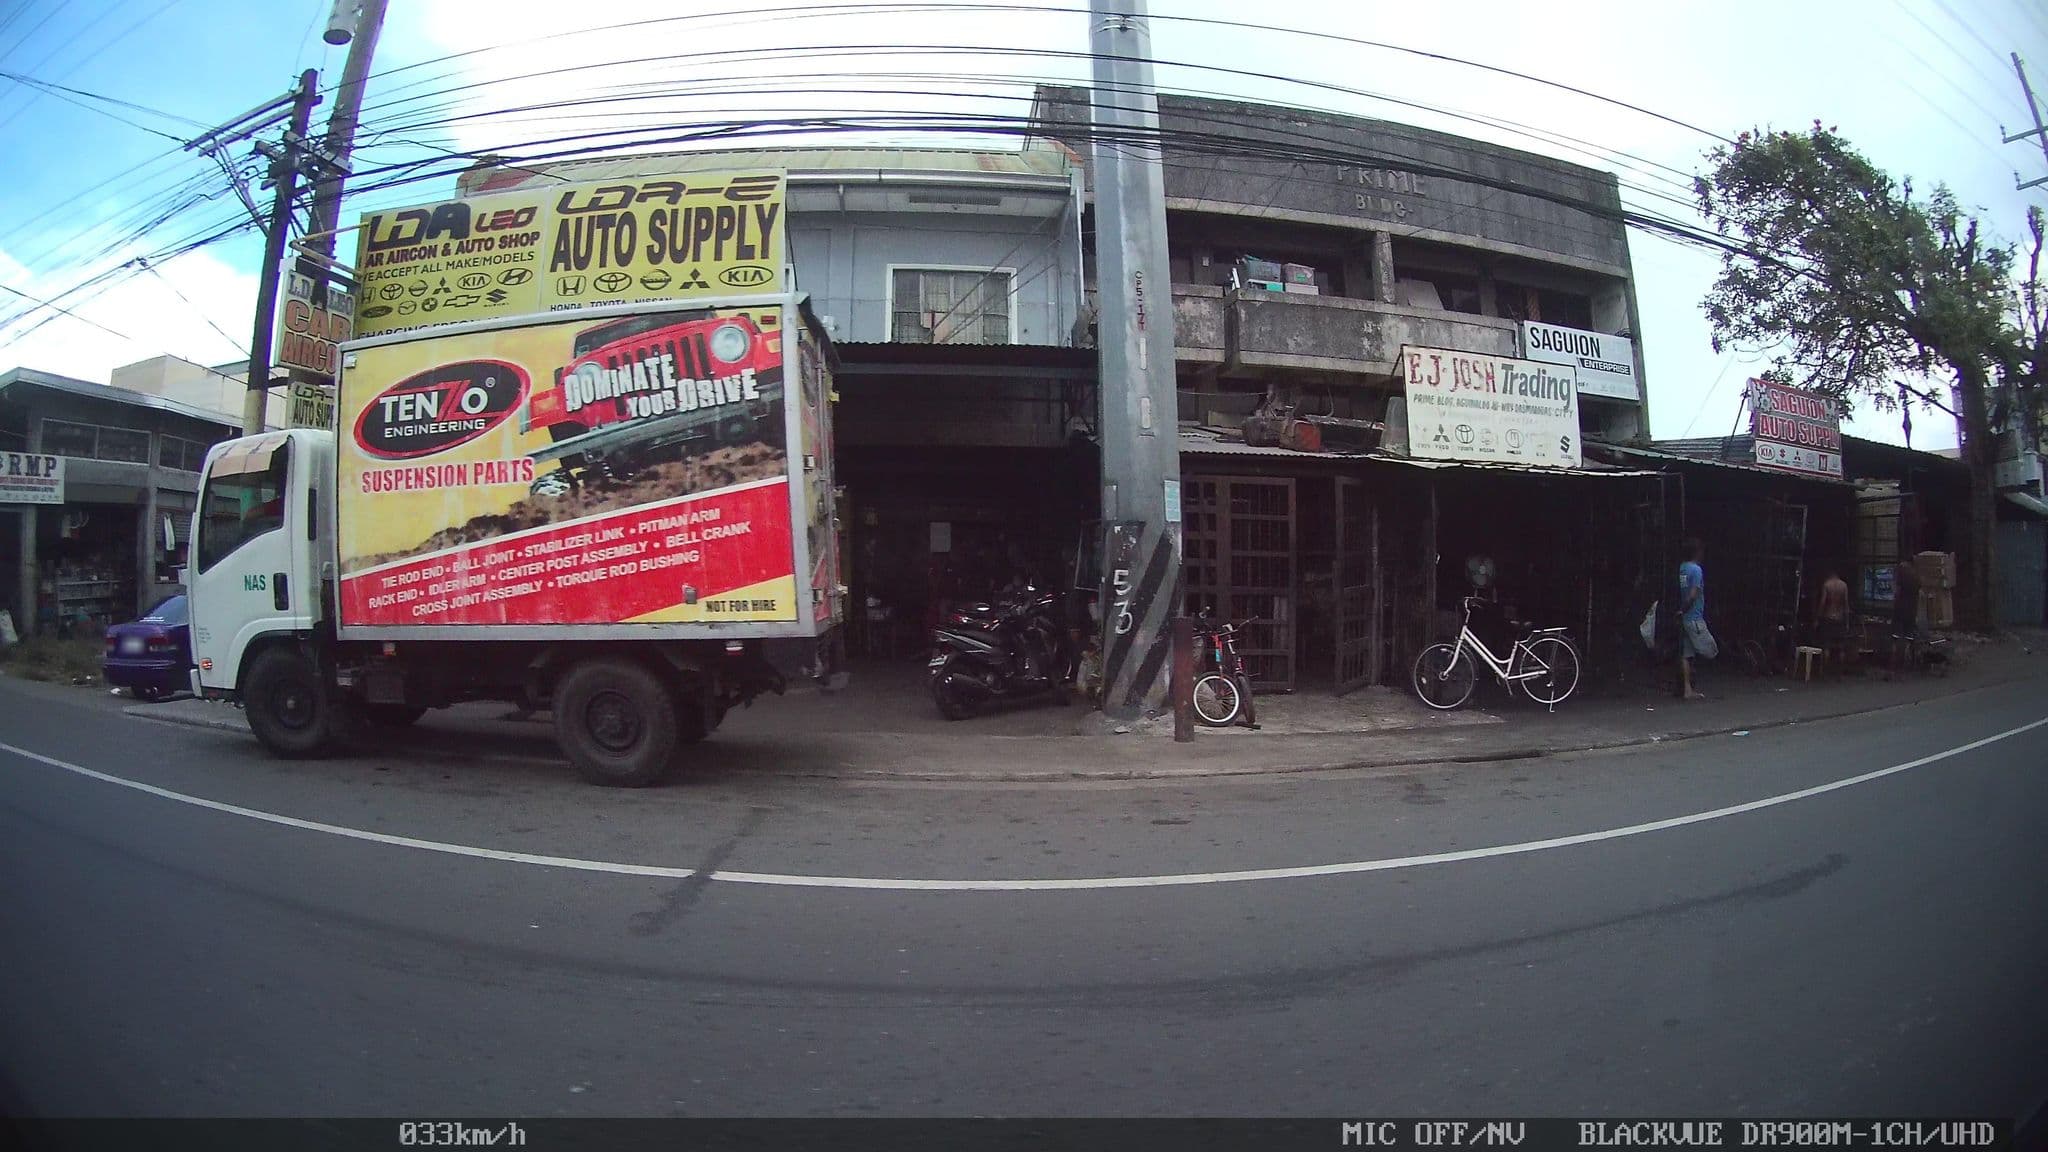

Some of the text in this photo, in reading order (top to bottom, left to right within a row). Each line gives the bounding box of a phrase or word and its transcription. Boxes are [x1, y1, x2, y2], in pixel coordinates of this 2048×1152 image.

[368, 202, 539, 252] LDA LEO
[549, 203, 780, 273] AUTO SUPPLY
[386, 244, 439, 263] AIRCON
[441, 242, 452, 256] &
[455, 238, 496, 256] AUTO
[498, 231, 541, 249] SHOP
[375, 264, 421, 280] ACCEPT
[420, 261, 443, 274] ALL
[445, 251, 536, 271] MAKE/MODELS
[461, 277, 487, 287] KIA
[727, 274, 766, 283] KIA
[285, 299, 352, 344] CAR
[280, 332, 338, 375] AIRCO
[1530, 326, 1601, 358] SAGUION
[564, 354, 677, 412] DOMINATE
[1584, 360, 1630, 374] ENTERPRISE
[295, 385, 334, 401] LDR-
[379, 380, 488, 423] TENZO
[627, 368, 760, 418] YOUR DRIVE
[1501, 363, 1571, 412] Trading
[293, 398, 334, 431] AUTO SUP
[1770, 389, 1826, 421] SAGUION
[384, 419, 486, 438] ENGINEERING
[1760, 414, 1797, 442] AUTO
[362, 458, 535, 494] SUSPENSION PARTS
[382, 508, 721, 588] TIE ROD END BALL JOINT STABILIZER LINK PITMAN ARM
[368, 521, 752, 609] RACK END IDLER ARM CENTER POST ASSEMBLY BELL CRANK
[244, 575, 266, 591] NAS
[412, 550, 700, 617] CROSS JOINT ASSEMBLY TORQUE ROD BUSHING
[706, 599, 777, 612] NOT FOR HIRE
